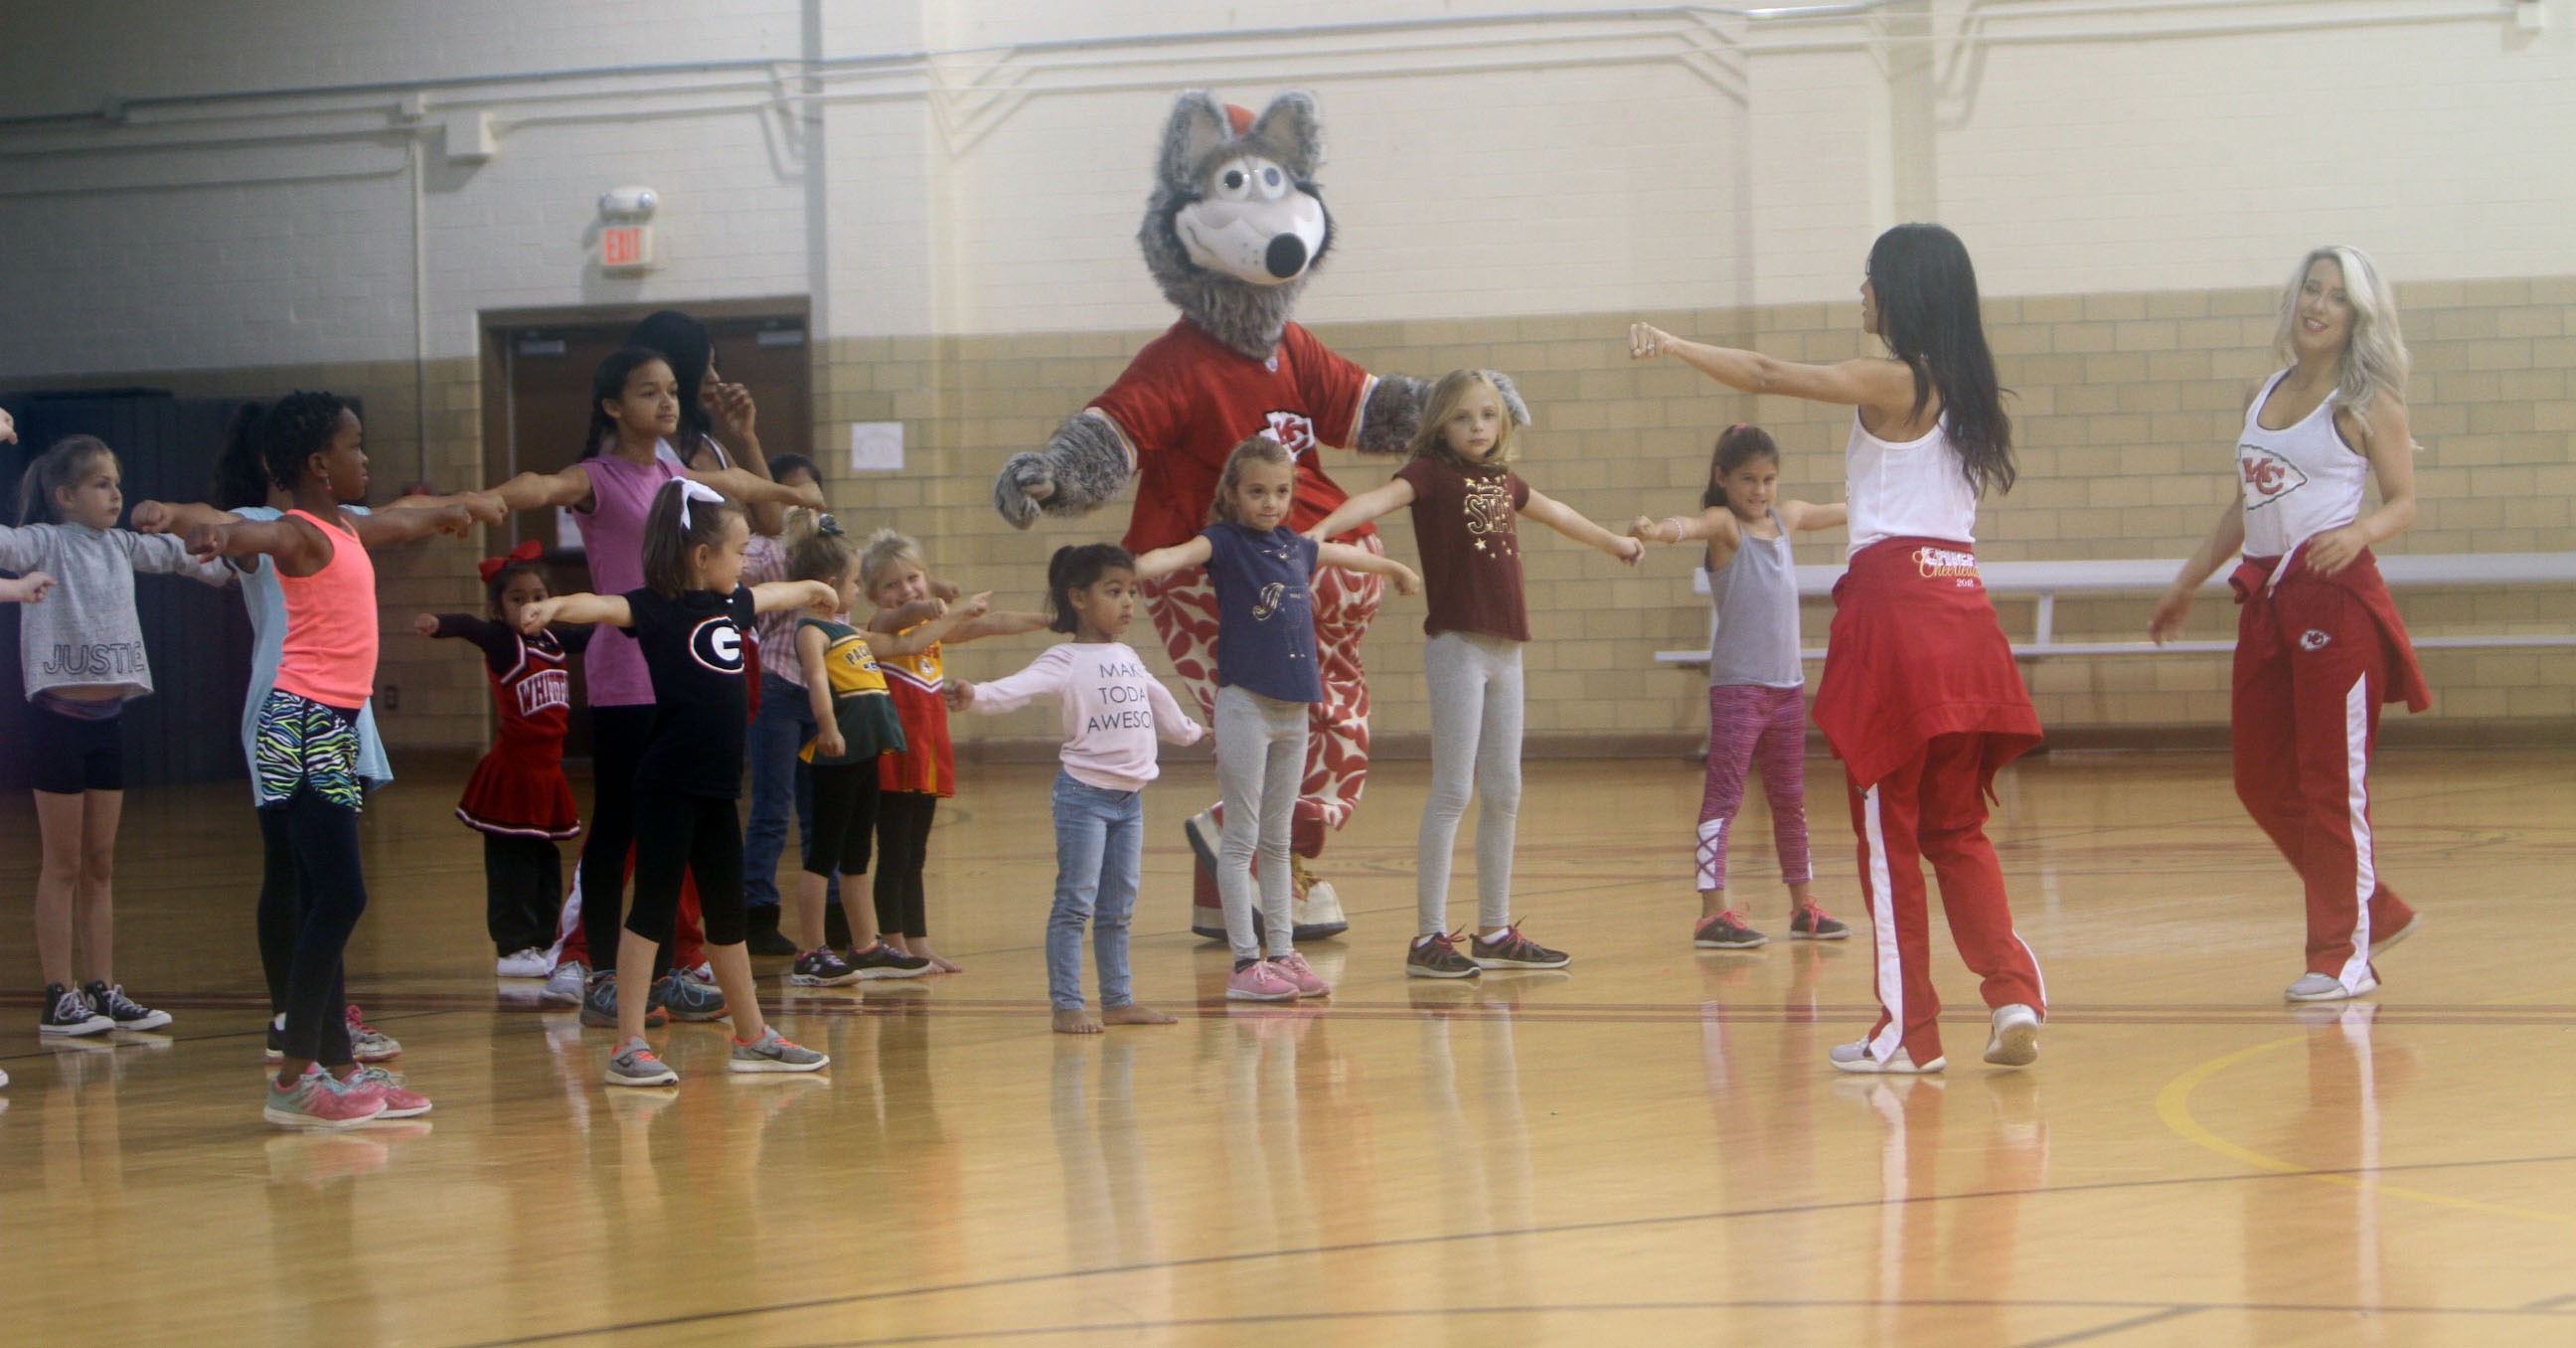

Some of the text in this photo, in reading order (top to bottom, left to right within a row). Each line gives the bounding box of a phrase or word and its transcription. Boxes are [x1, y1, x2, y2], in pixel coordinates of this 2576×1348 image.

[603, 228, 641, 264] EXIT
[2242, 457, 2286, 495] KC
[1920, 546, 1976, 568] CHIEF
[688, 614, 744, 674] G
[844, 643, 874, 668] PAC
[1099, 662, 1144, 678] MAK
[1097, 685, 1146, 705] TODA
[1087, 710, 1152, 734] AWESO
